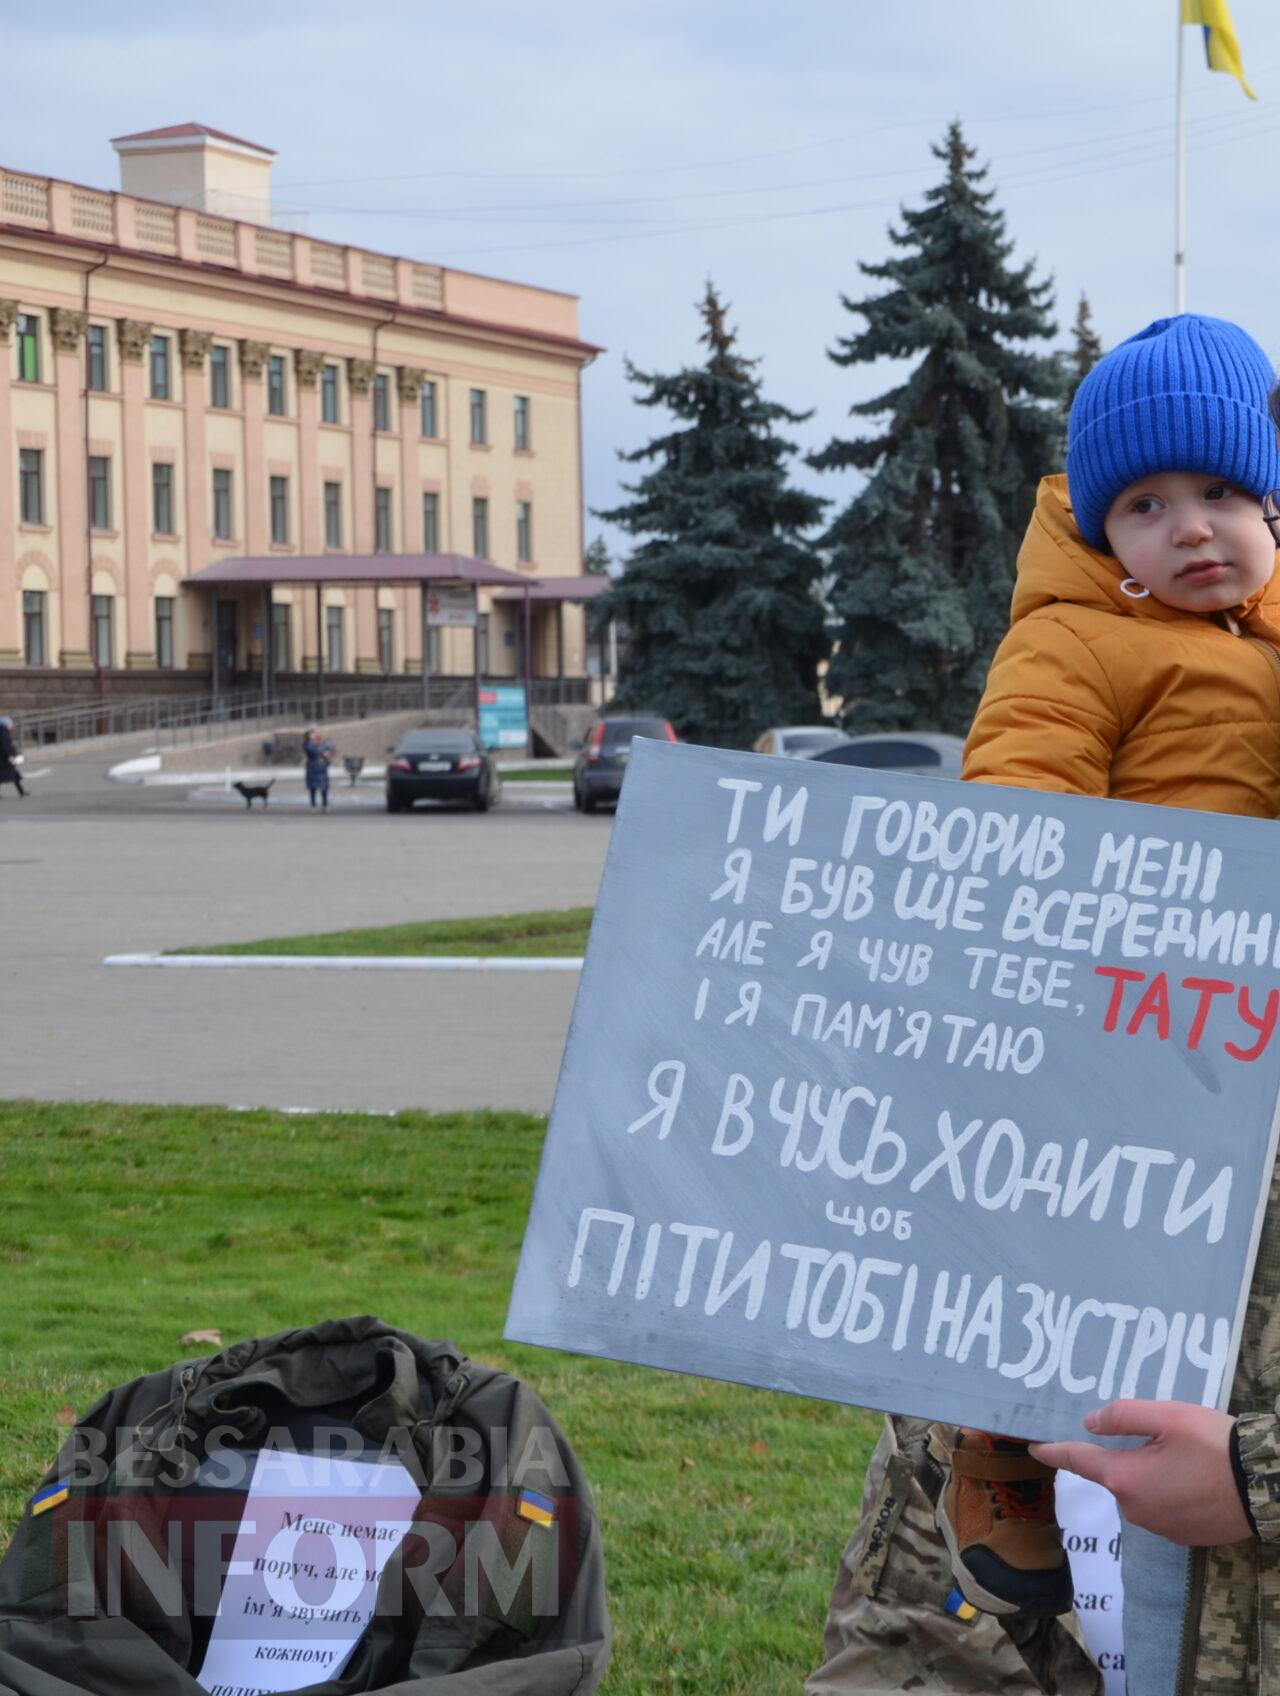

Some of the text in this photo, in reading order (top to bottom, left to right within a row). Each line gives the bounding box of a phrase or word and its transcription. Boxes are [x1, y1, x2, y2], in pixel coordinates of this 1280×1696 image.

[717, 778, 1223, 903] ТИ ГОВОРИВ МЕНІ
[709, 848, 752, 904] Я
[780, 857, 874, 921] БУВ
[894, 867, 990, 931] ЩЕ
[694, 978, 709, 1020] І
[725, 981, 761, 1026] Я
[695, 917, 1280, 1062] АЛЕ Я ЧУВ ТЕБЕ, ТАТУ
[627, 1060, 686, 1140] Я
[910, 1111, 1233, 1244] ХОДИТИ
[567, 1207, 771, 1321] ПІТИ
[780, 1243, 918, 1351] ТОБІ
[280, 1511, 399, 1542] Мене немає
[1061, 1529, 1098, 1553] оя
[253, 1557, 318, 1580] поруч,
[325, 1566, 358, 1582] але
[290, 1606, 361, 1625] звучить
[254, 1646, 338, 1668] кожному
